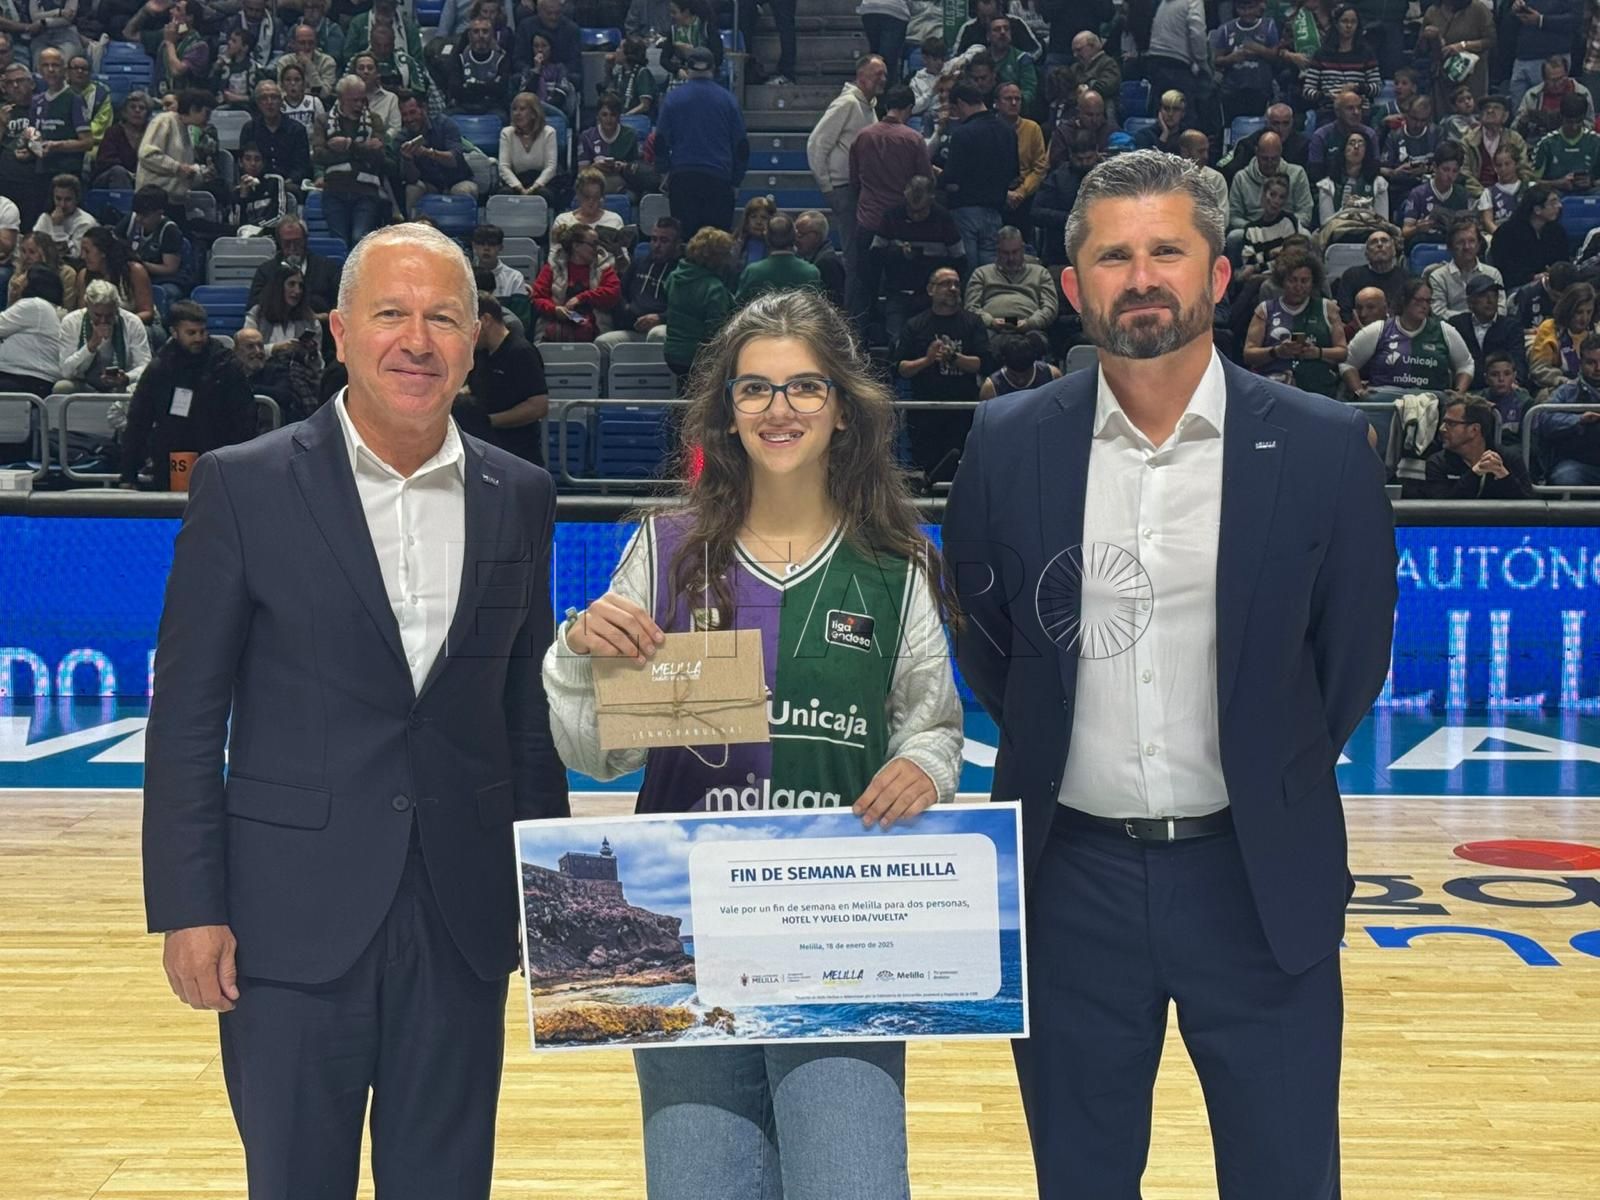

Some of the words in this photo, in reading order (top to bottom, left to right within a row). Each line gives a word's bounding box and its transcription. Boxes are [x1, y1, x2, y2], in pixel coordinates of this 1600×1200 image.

[1402, 355, 1438, 367] Unicaja
[1396, 536, 1600, 590] AUTÓN
[831, 620, 852, 632] liga
[831, 631, 871, 647] endesa
[767, 698, 868, 739] Unicaja
[730, 868, 757, 883] FIN
[762, 867, 783, 881] DE
[787, 865, 856, 880] SEMANA
[861, 864, 882, 878] EN
[886, 862, 956, 877] MELILLA
[720, 905, 739, 915] Vale
[741, 905, 757, 916] por
[759, 905, 771, 913] un
[773, 903, 785, 913] fin
[787, 902, 799, 912] de
[800, 903, 836, 912] semana
[838, 902, 850, 911] en
[852, 900, 882, 911] Melilla
[884, 901, 905, 912] para
[907, 899, 924, 909] dos
[926, 899, 970, 911] personas,
[782, 916, 811, 925] HOTEL
[813, 915, 820, 924] Y
[820, 914, 851, 923] VUELO
[877, 941, 894, 949] 2025
